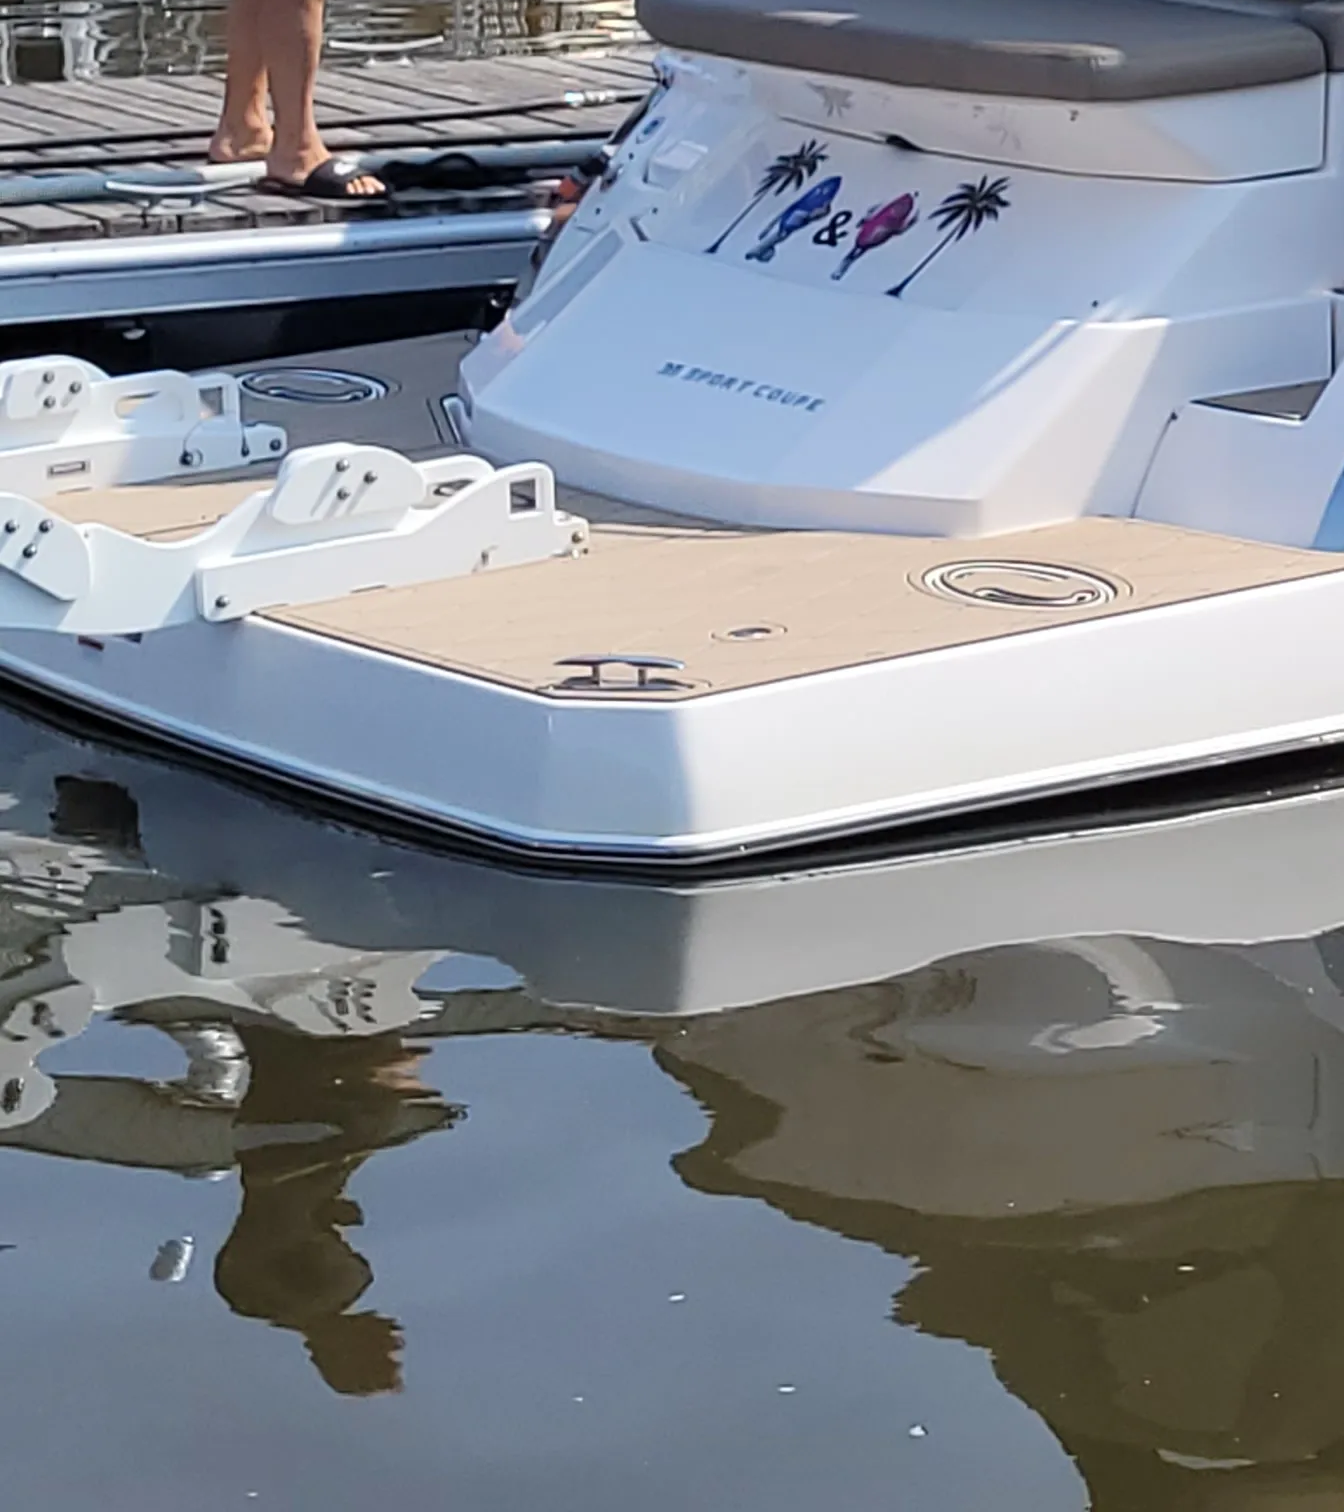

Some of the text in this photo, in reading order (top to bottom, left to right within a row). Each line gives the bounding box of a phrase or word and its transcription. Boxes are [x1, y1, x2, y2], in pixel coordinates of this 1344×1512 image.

[812, 210, 852, 247] &
[681, 367, 754, 393] SPORT
[752, 384, 826, 412] COUPE
